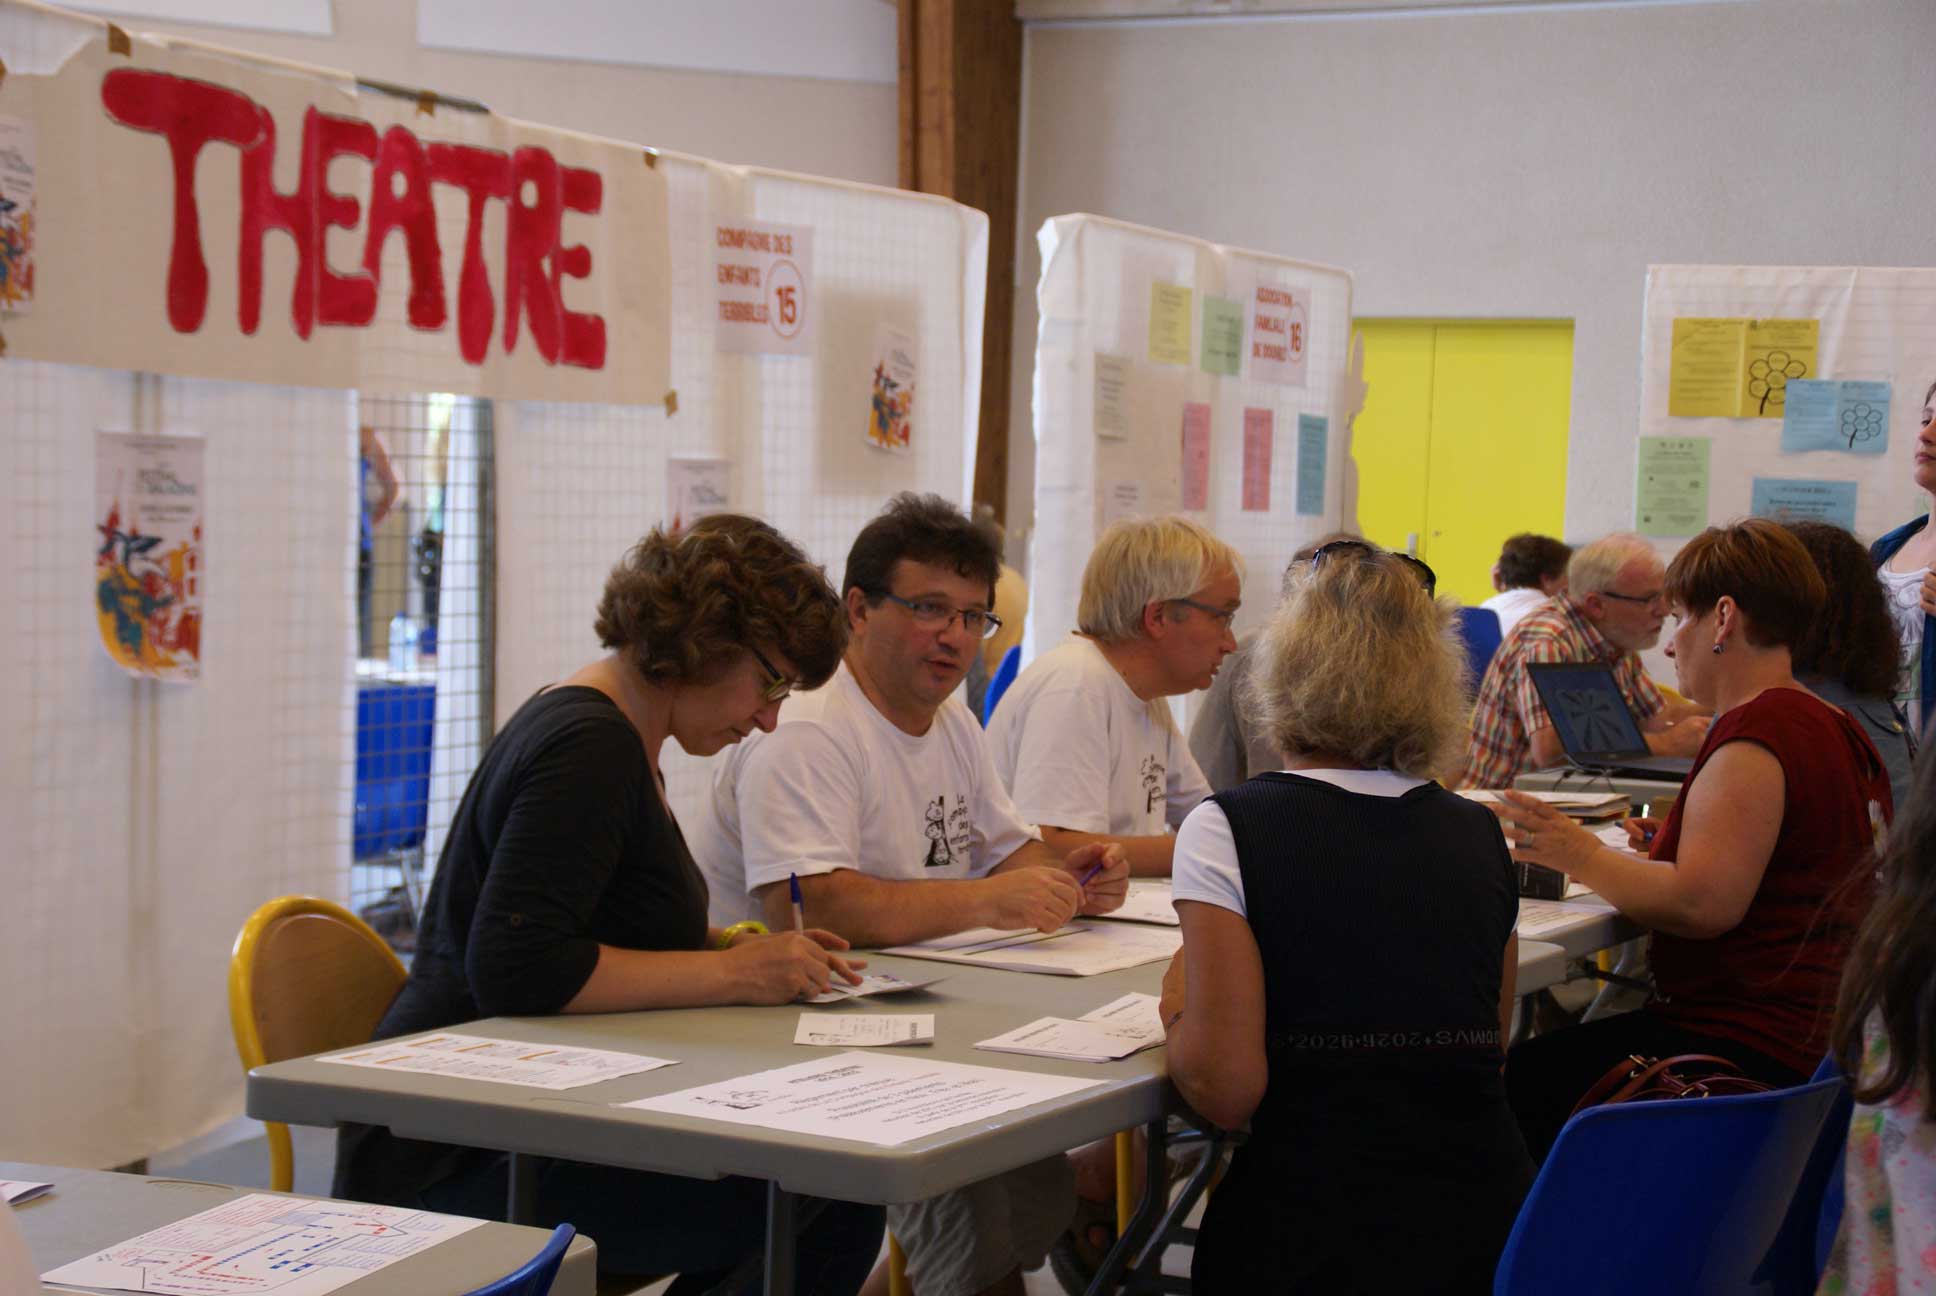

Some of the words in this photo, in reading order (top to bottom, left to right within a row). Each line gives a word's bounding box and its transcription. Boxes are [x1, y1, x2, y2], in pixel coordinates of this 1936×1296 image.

[102, 68, 607, 370] THEATRE
[773, 233, 793, 255] DES
[717, 264, 761, 288] ENFANTS
[776, 286, 797, 325] 15
[1290, 322, 1302, 352] 16
